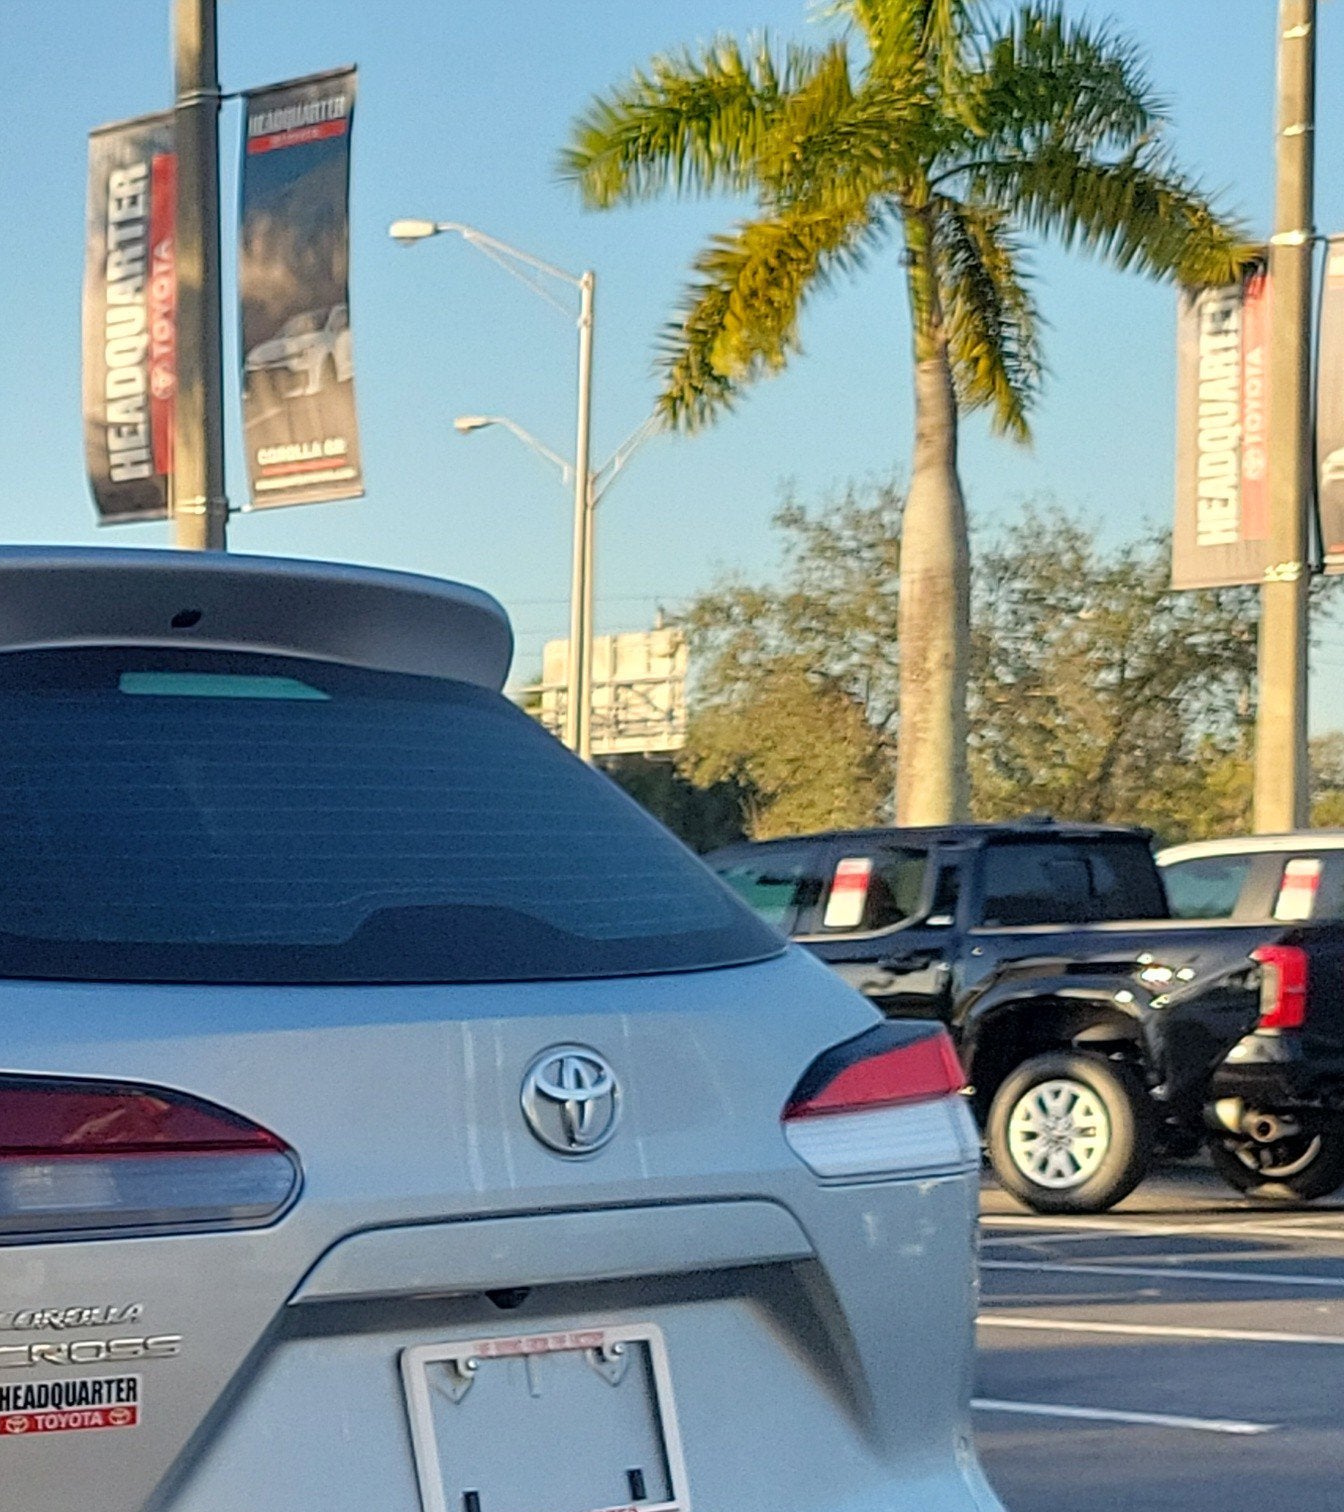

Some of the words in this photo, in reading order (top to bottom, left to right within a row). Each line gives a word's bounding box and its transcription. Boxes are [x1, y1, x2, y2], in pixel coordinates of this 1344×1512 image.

[105, 161, 153, 484] HEADQUARTER
[151, 236, 174, 362] TOYOTA
[34, 1412, 104, 1431] TOYOTA
